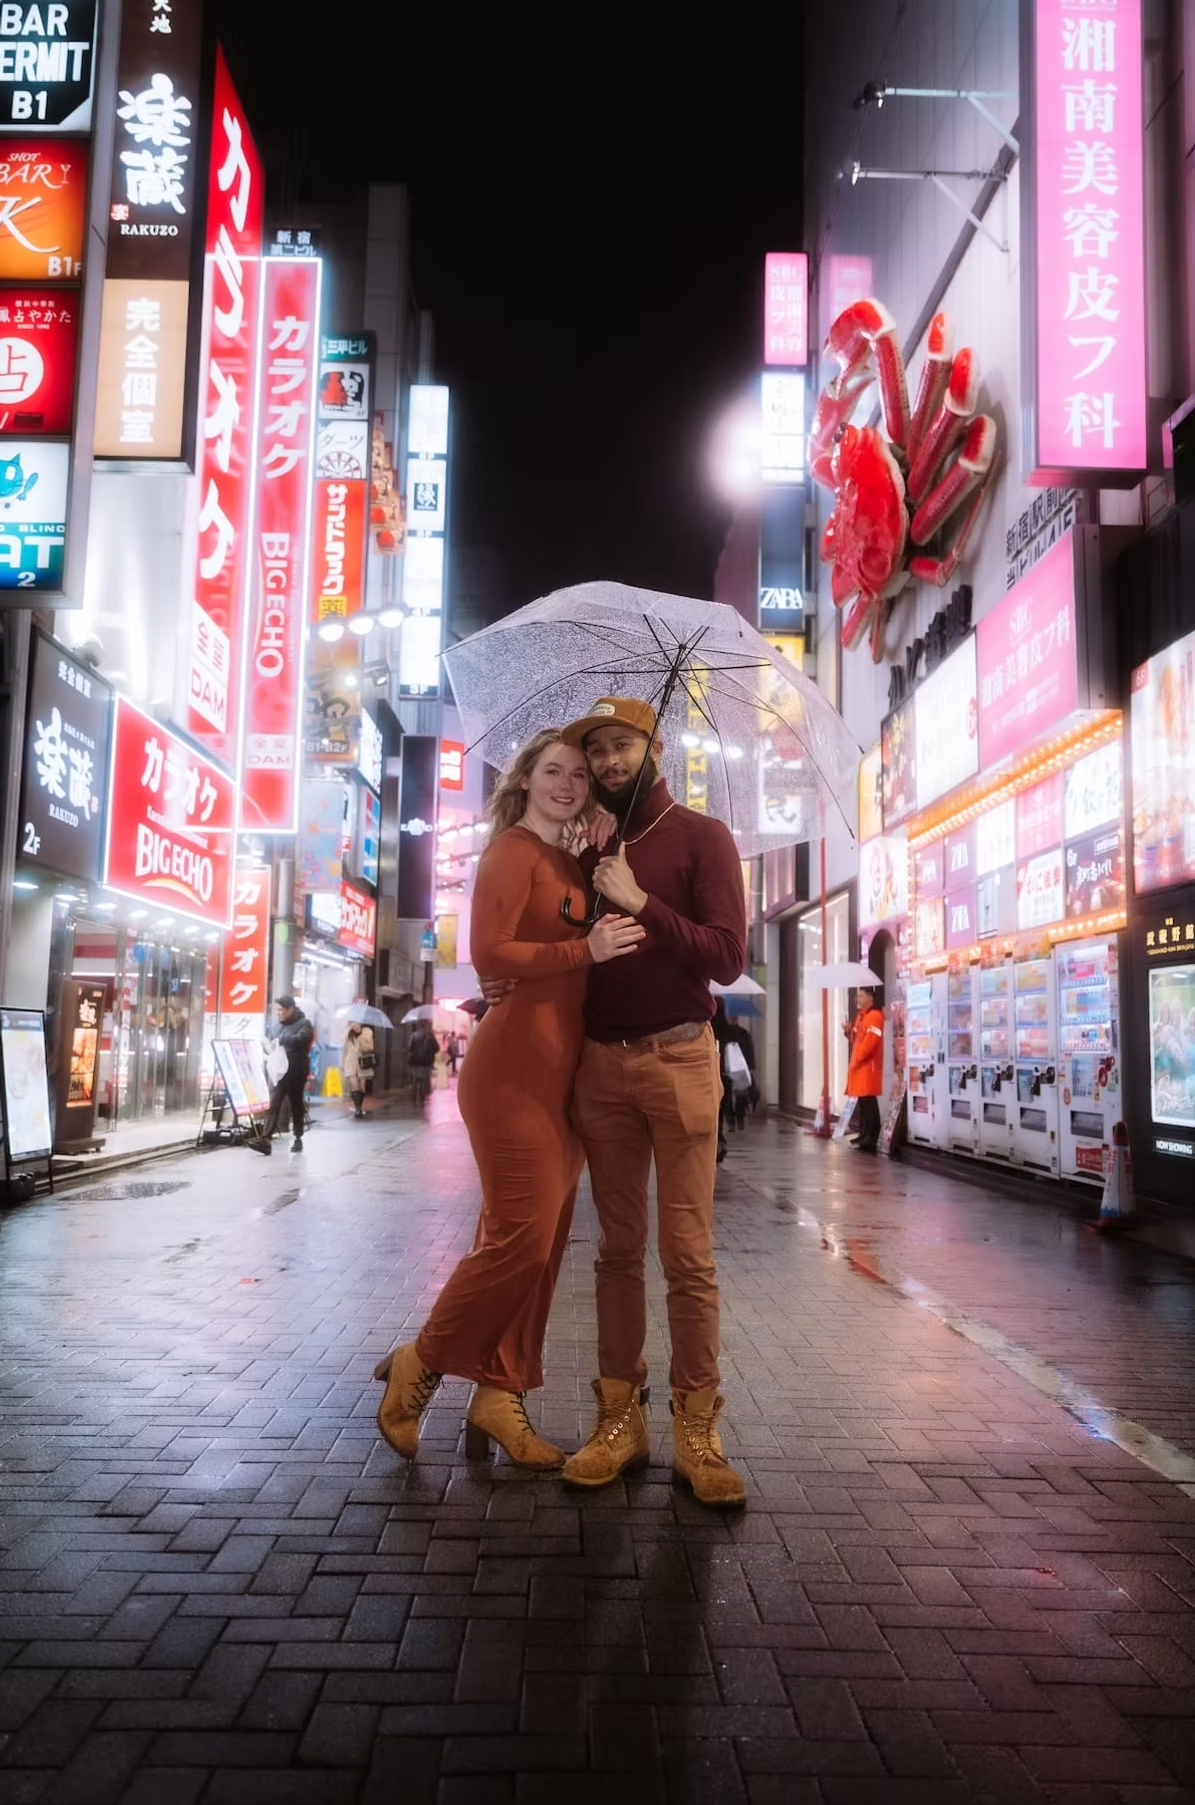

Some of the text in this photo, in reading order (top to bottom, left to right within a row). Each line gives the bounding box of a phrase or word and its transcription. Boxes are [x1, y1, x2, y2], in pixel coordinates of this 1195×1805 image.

[0, 3, 69, 36] BAR
[0, 42, 90, 82] ERMIT
[12, 90, 47, 120] B1
[8, 152, 41, 163] SHOT
[117, 73, 192, 215] 楽蔵
[0, 164, 62, 189] BAR
[120, 224, 179, 236] RAKUZO
[1061, 17, 1121, 449] 湘南美容皮フ科
[48, 256, 82, 277] B1F
[118, 297, 161, 443] 完全個室
[261, 316, 311, 479] カラオケ
[1006, 488, 1075, 557] 新宿駅前
[17, 571, 36, 587] 2
[760, 587, 803, 609] ZARA
[255, 532, 290, 678] BIG ECHO
[191, 668, 225, 720] DAM
[34, 707, 94, 821] 楽蔵
[141, 737, 218, 822] カラオケ
[247, 755, 291, 766] DAM
[48, 803, 79, 828] RAKUZO
[23, 822, 41, 855] 2F
[136, 823, 213, 902] BIG ECHO
[230, 882, 261, 1006] カラオケ
